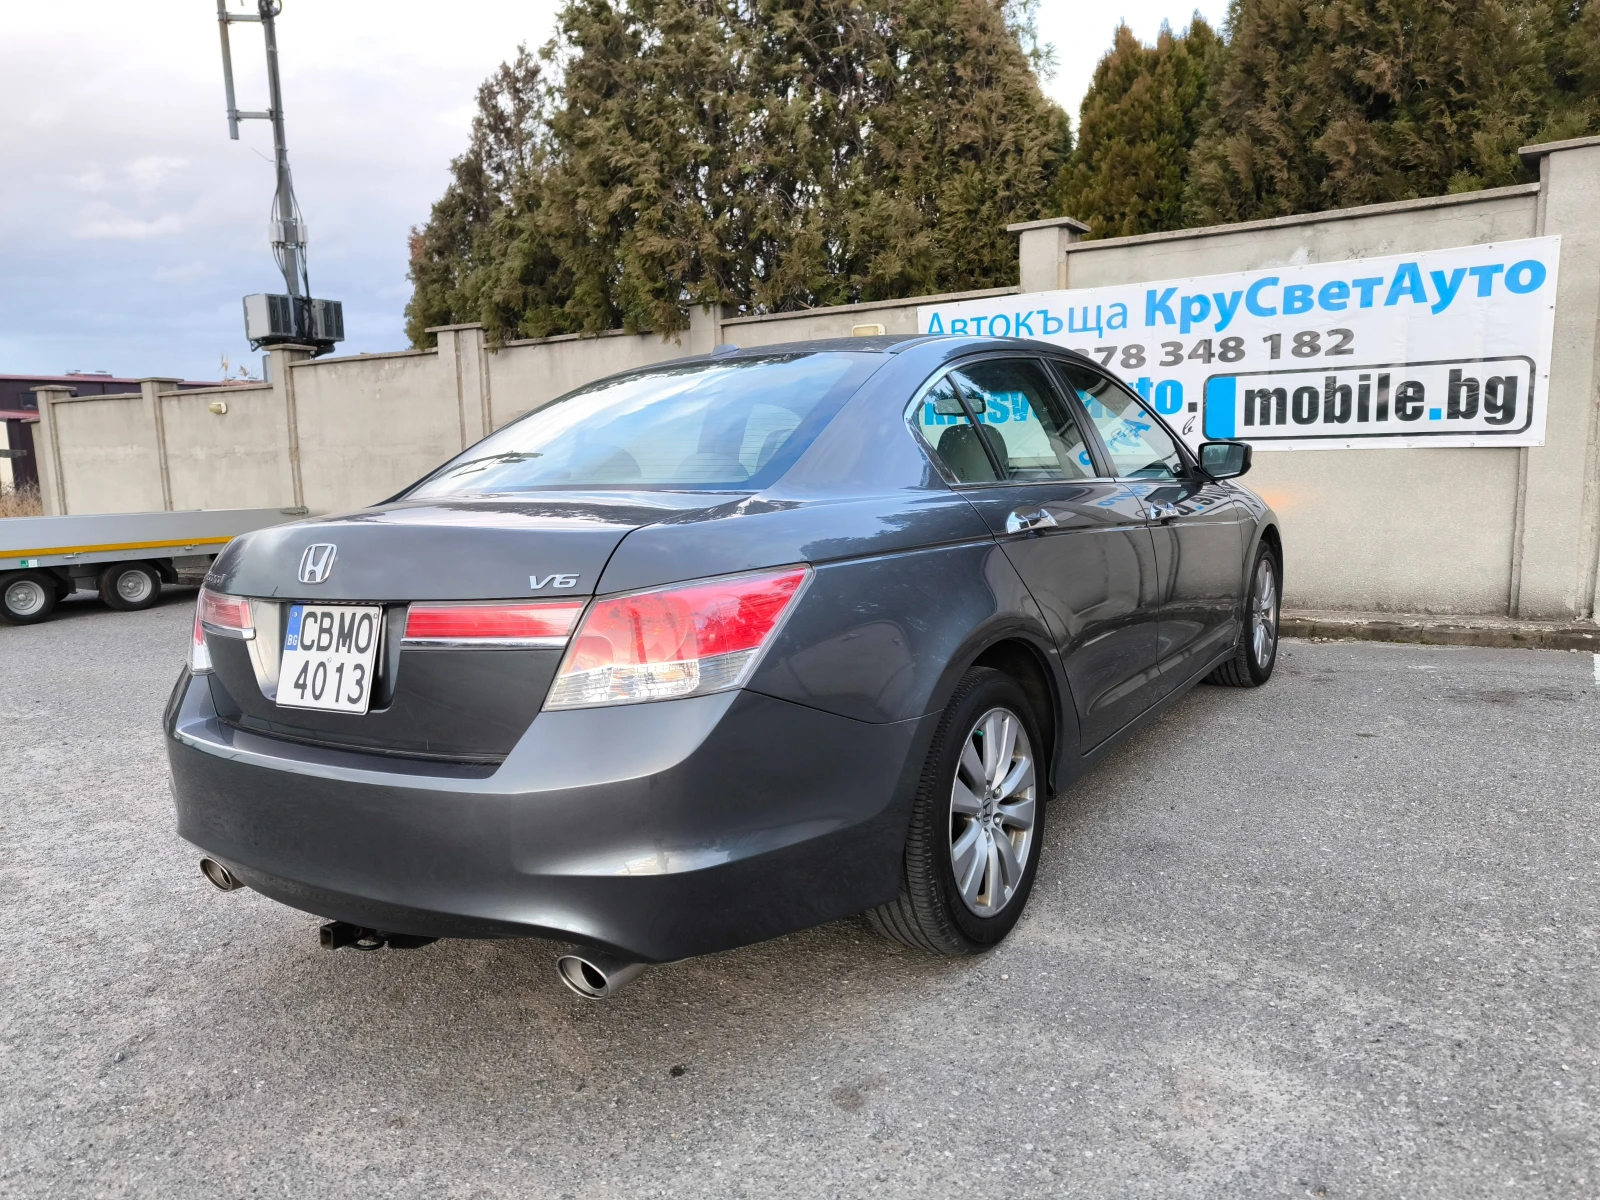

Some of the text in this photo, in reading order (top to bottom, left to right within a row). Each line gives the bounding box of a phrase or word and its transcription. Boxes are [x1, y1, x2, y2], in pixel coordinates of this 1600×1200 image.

[1145, 259, 1547, 335] КруСветАуто
[1158, 336, 1246, 368] 348
[1262, 328, 1356, 361] 182
[1243, 368, 1519, 427] mobile.bg
[529, 573, 580, 590] V6
[287, 634, 299, 646] BG
[293, 660, 366, 705] 4013
